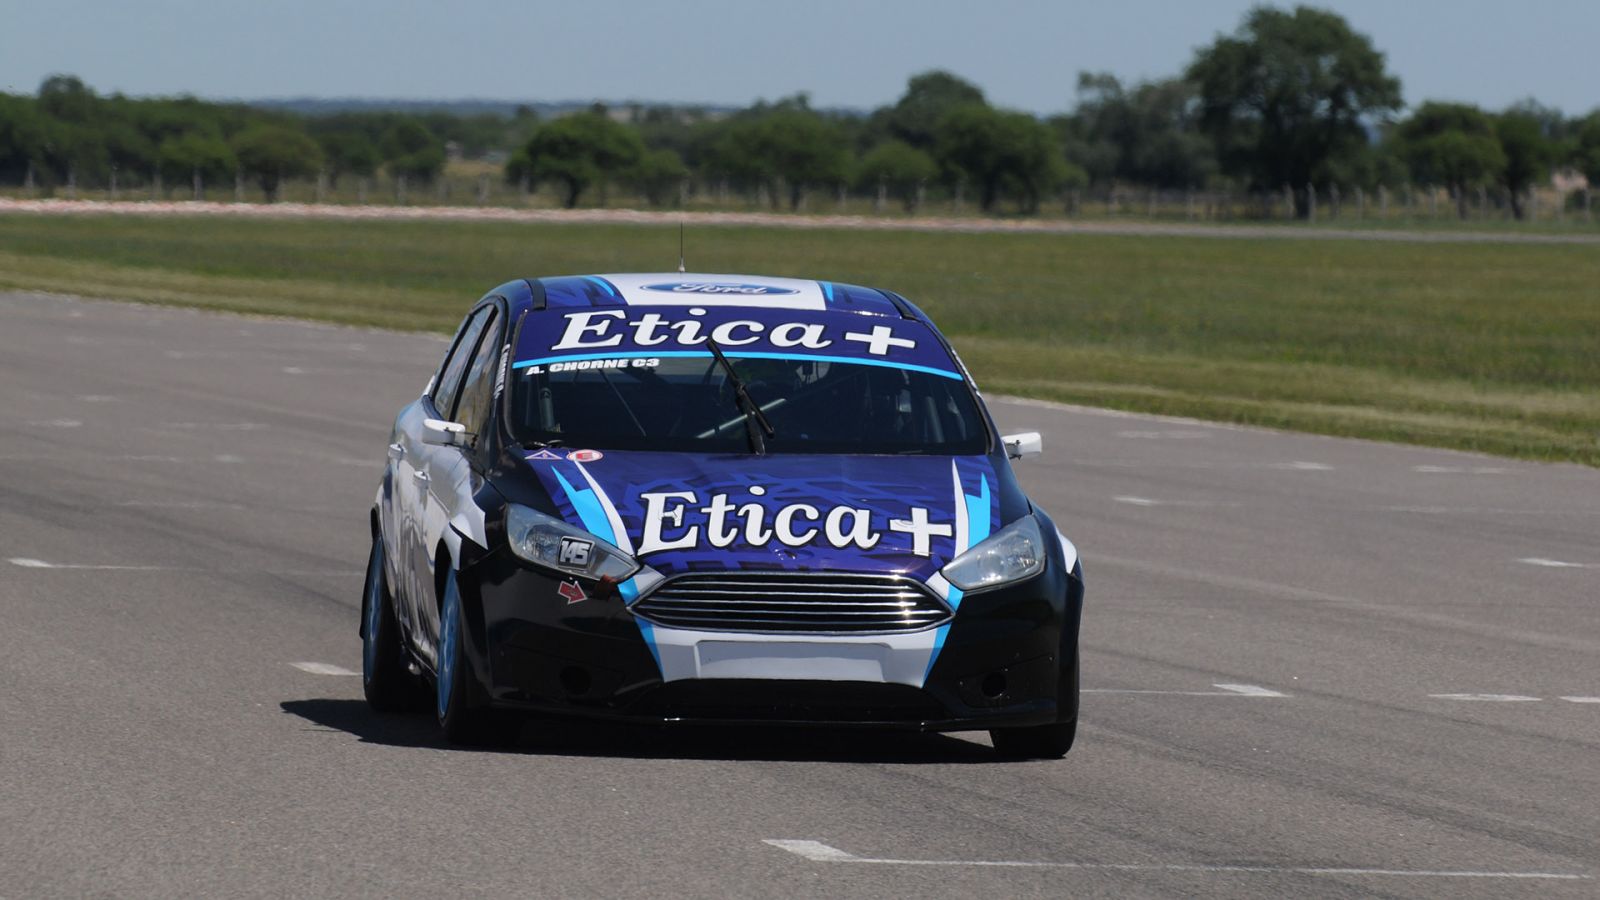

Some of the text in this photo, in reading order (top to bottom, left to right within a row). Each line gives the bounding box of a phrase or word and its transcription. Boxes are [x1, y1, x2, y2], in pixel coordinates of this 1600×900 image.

[671, 282, 768, 295] Ford
[525, 357, 660, 376] A. CHORNE C3
[559, 540, 591, 566] 145
